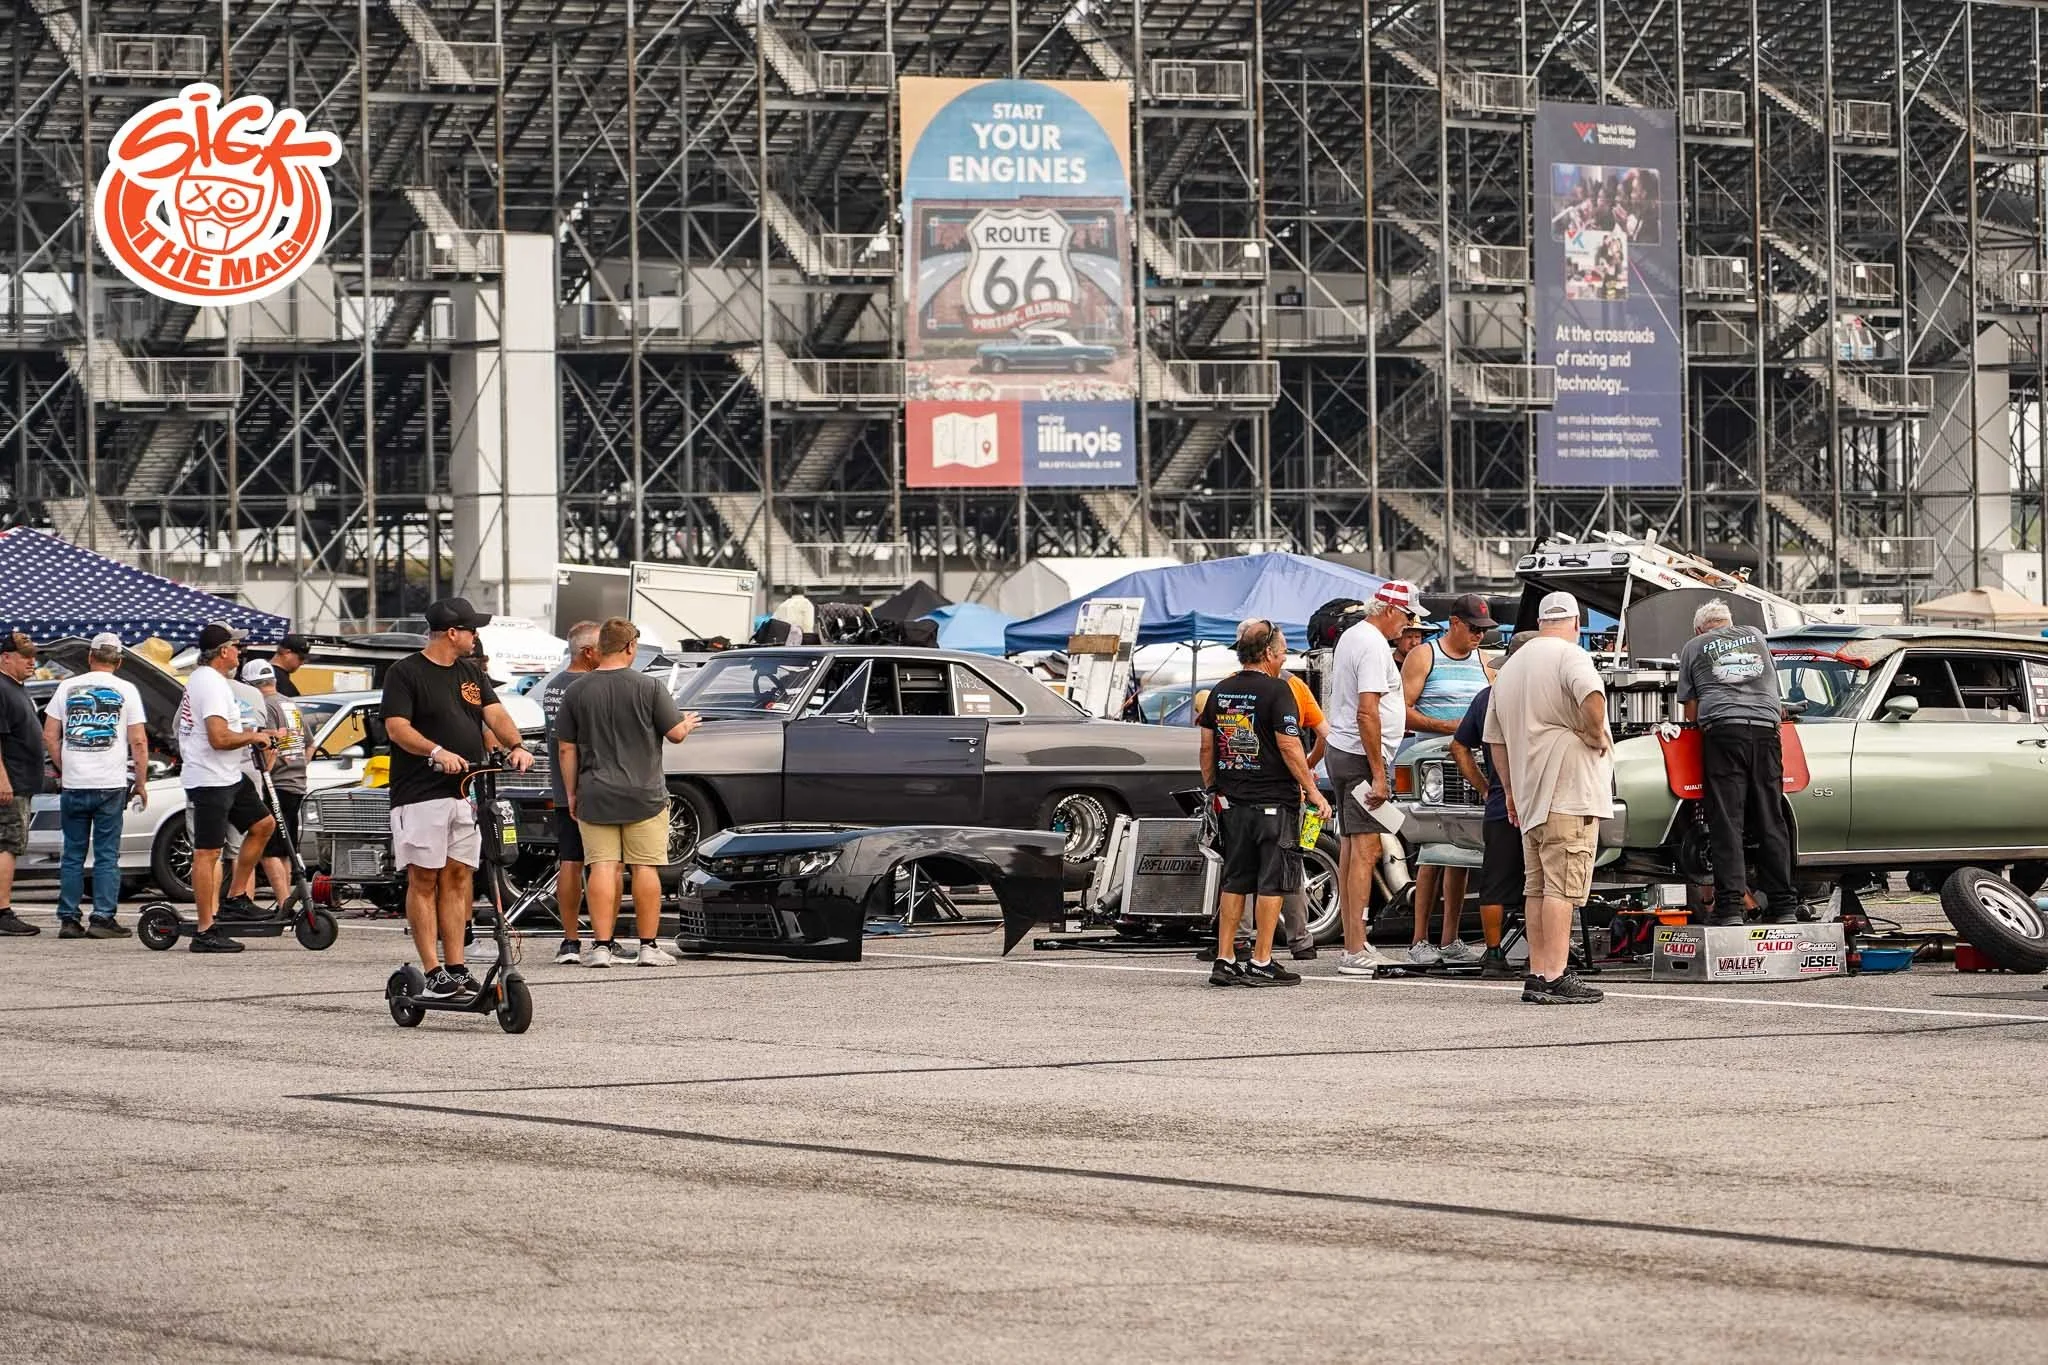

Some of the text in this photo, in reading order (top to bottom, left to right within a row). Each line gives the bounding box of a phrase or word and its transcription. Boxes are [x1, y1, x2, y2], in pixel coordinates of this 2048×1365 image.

[992, 103, 1045, 120] START
[972, 123, 1062, 150] YOUR
[1597, 123, 1636, 136] World Wide
[1598, 134, 1636, 149] Technology
[948, 155, 1087, 184] ENGINES
[985, 227, 1051, 243] ROUTE
[984, 256, 1058, 312] 66
[1025, 301, 1072, 319] ILLINOIS
[1556, 324, 1655, 344] At the crossroads
[1556, 350, 1631, 371] of racing and
[1591, 414, 1630, 426] innovation
[1703, 635, 1757, 654] FAT CHANCE
[68, 712, 119, 727] NMCA
[1813, 787, 1833, 797] SS
[1152, 859, 1201, 871] FLUIDYNE
[1664, 943, 1695, 954] CALICO
[1757, 941, 1793, 952] CALICO
[1719, 957, 1766, 970] VALLEY
[1801, 955, 1839, 967] JESEL
